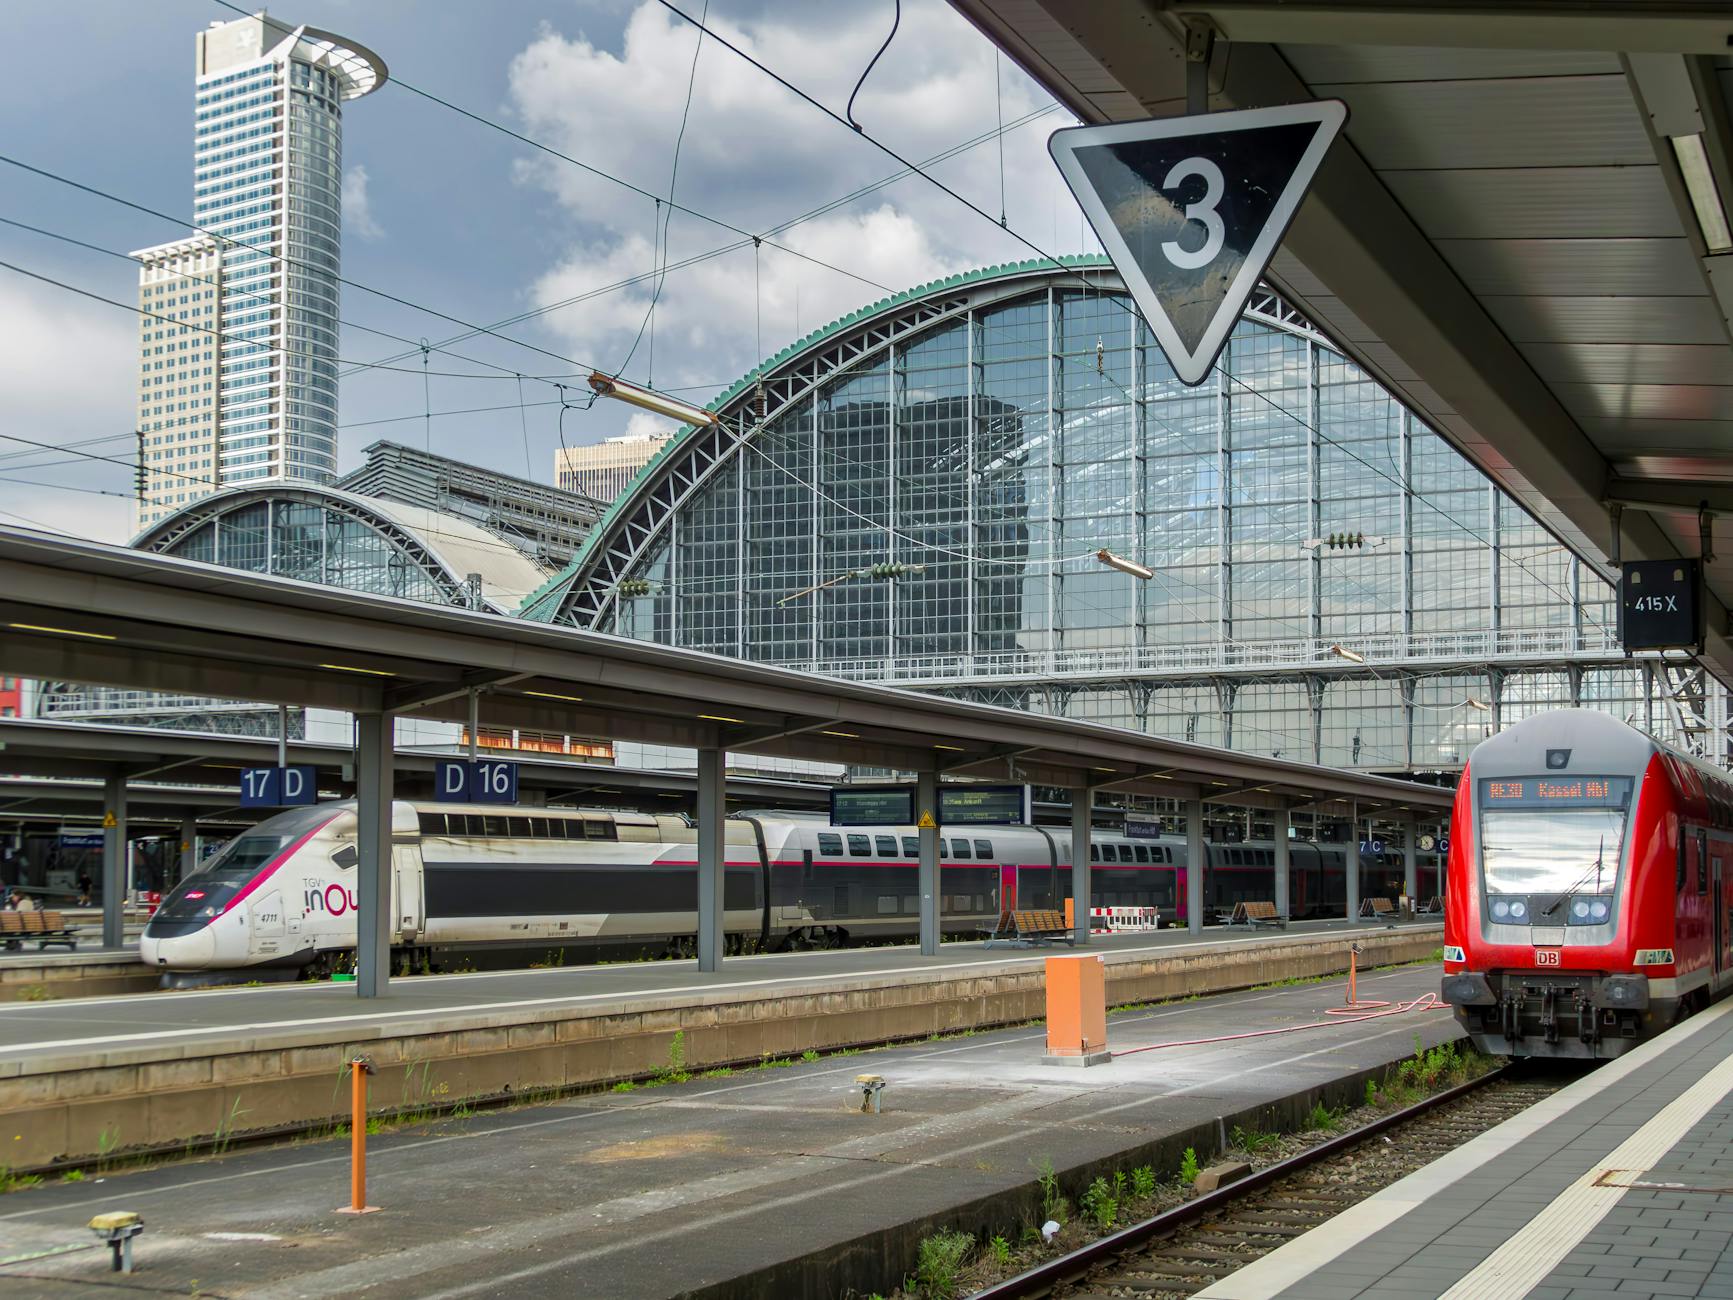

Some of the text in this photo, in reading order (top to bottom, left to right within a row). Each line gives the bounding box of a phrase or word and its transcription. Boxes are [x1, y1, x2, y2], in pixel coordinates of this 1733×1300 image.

[1161, 156, 1226, 270] 3
[244, 768, 303, 798] 17 D
[446, 763, 510, 794] D 16
[1490, 783, 1523, 798] RE30
[1538, 782, 1581, 797] Kassel
[1372, 840, 1381, 852] C
[303, 879, 321, 888] TGV
[261, 914, 278, 923] 4711
[1538, 952, 1558, 965] DB
